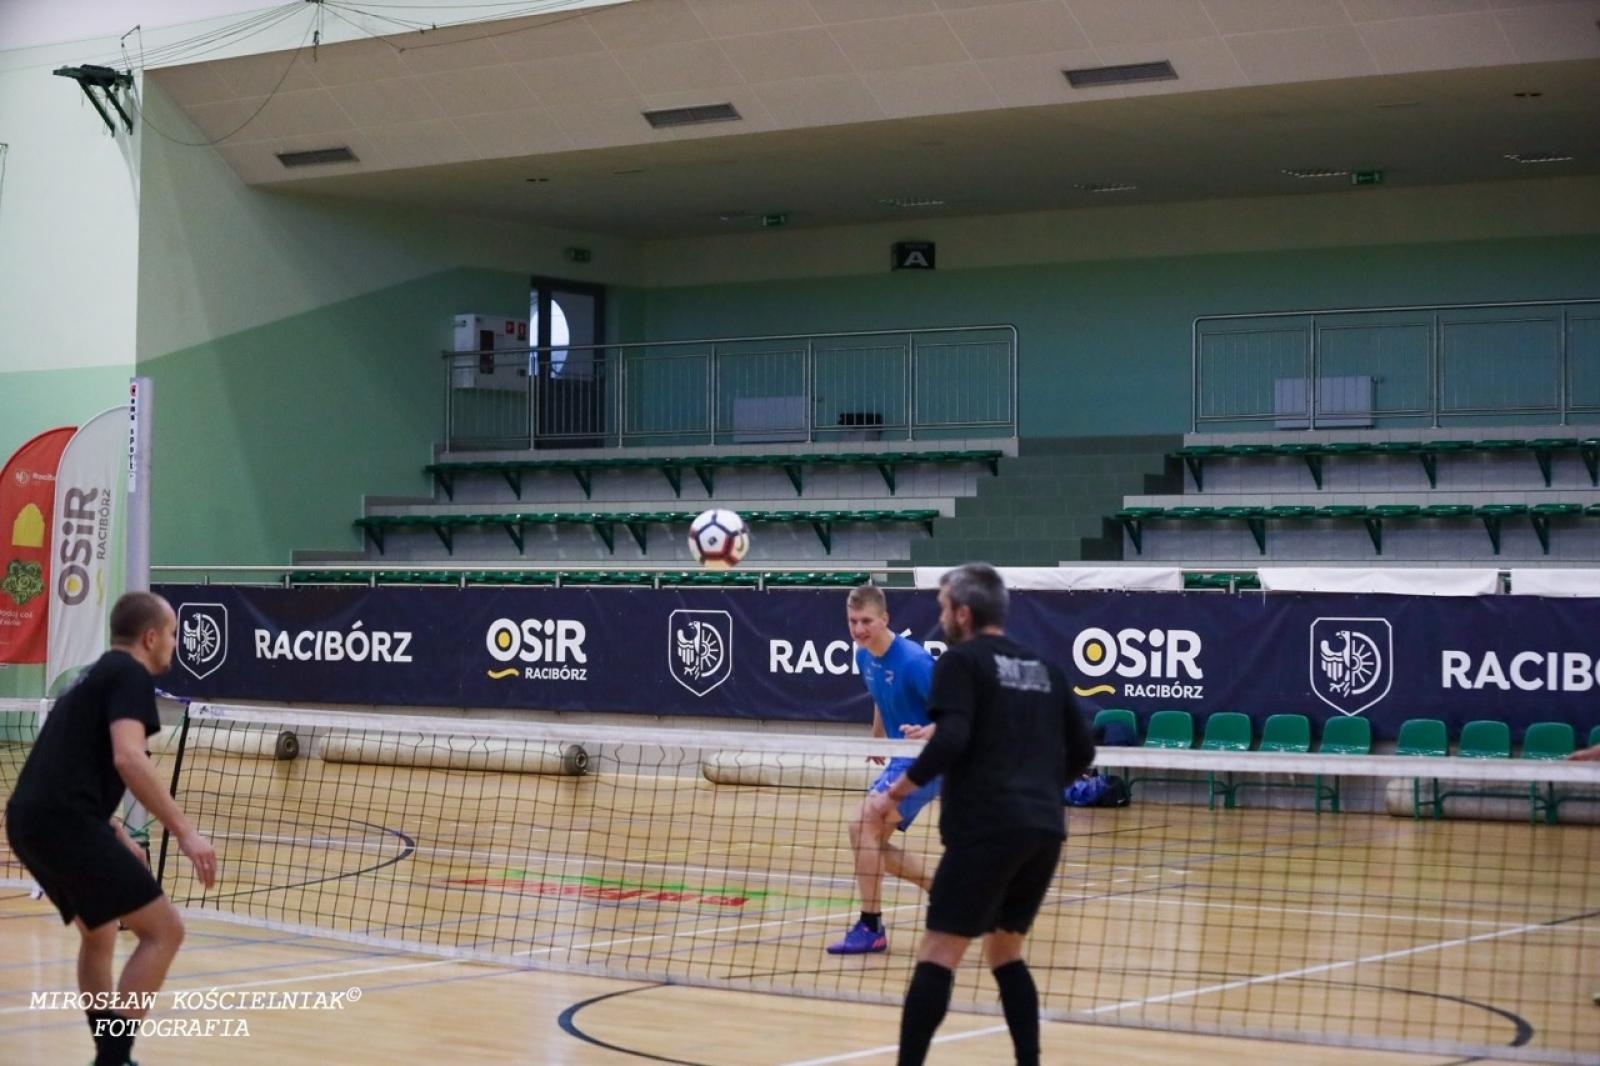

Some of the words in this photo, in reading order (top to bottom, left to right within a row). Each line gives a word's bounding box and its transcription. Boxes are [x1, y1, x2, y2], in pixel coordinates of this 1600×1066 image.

[903, 250, 929, 267] A
[97, 488, 111, 561] RACIBÓRZ
[254, 620, 413, 663] RACIBÓRZ
[525, 665, 587, 681] RACIBÓRZ
[1441, 649, 1600, 691] RACIB
[1124, 678, 1204, 699] RACIBÓRZ
